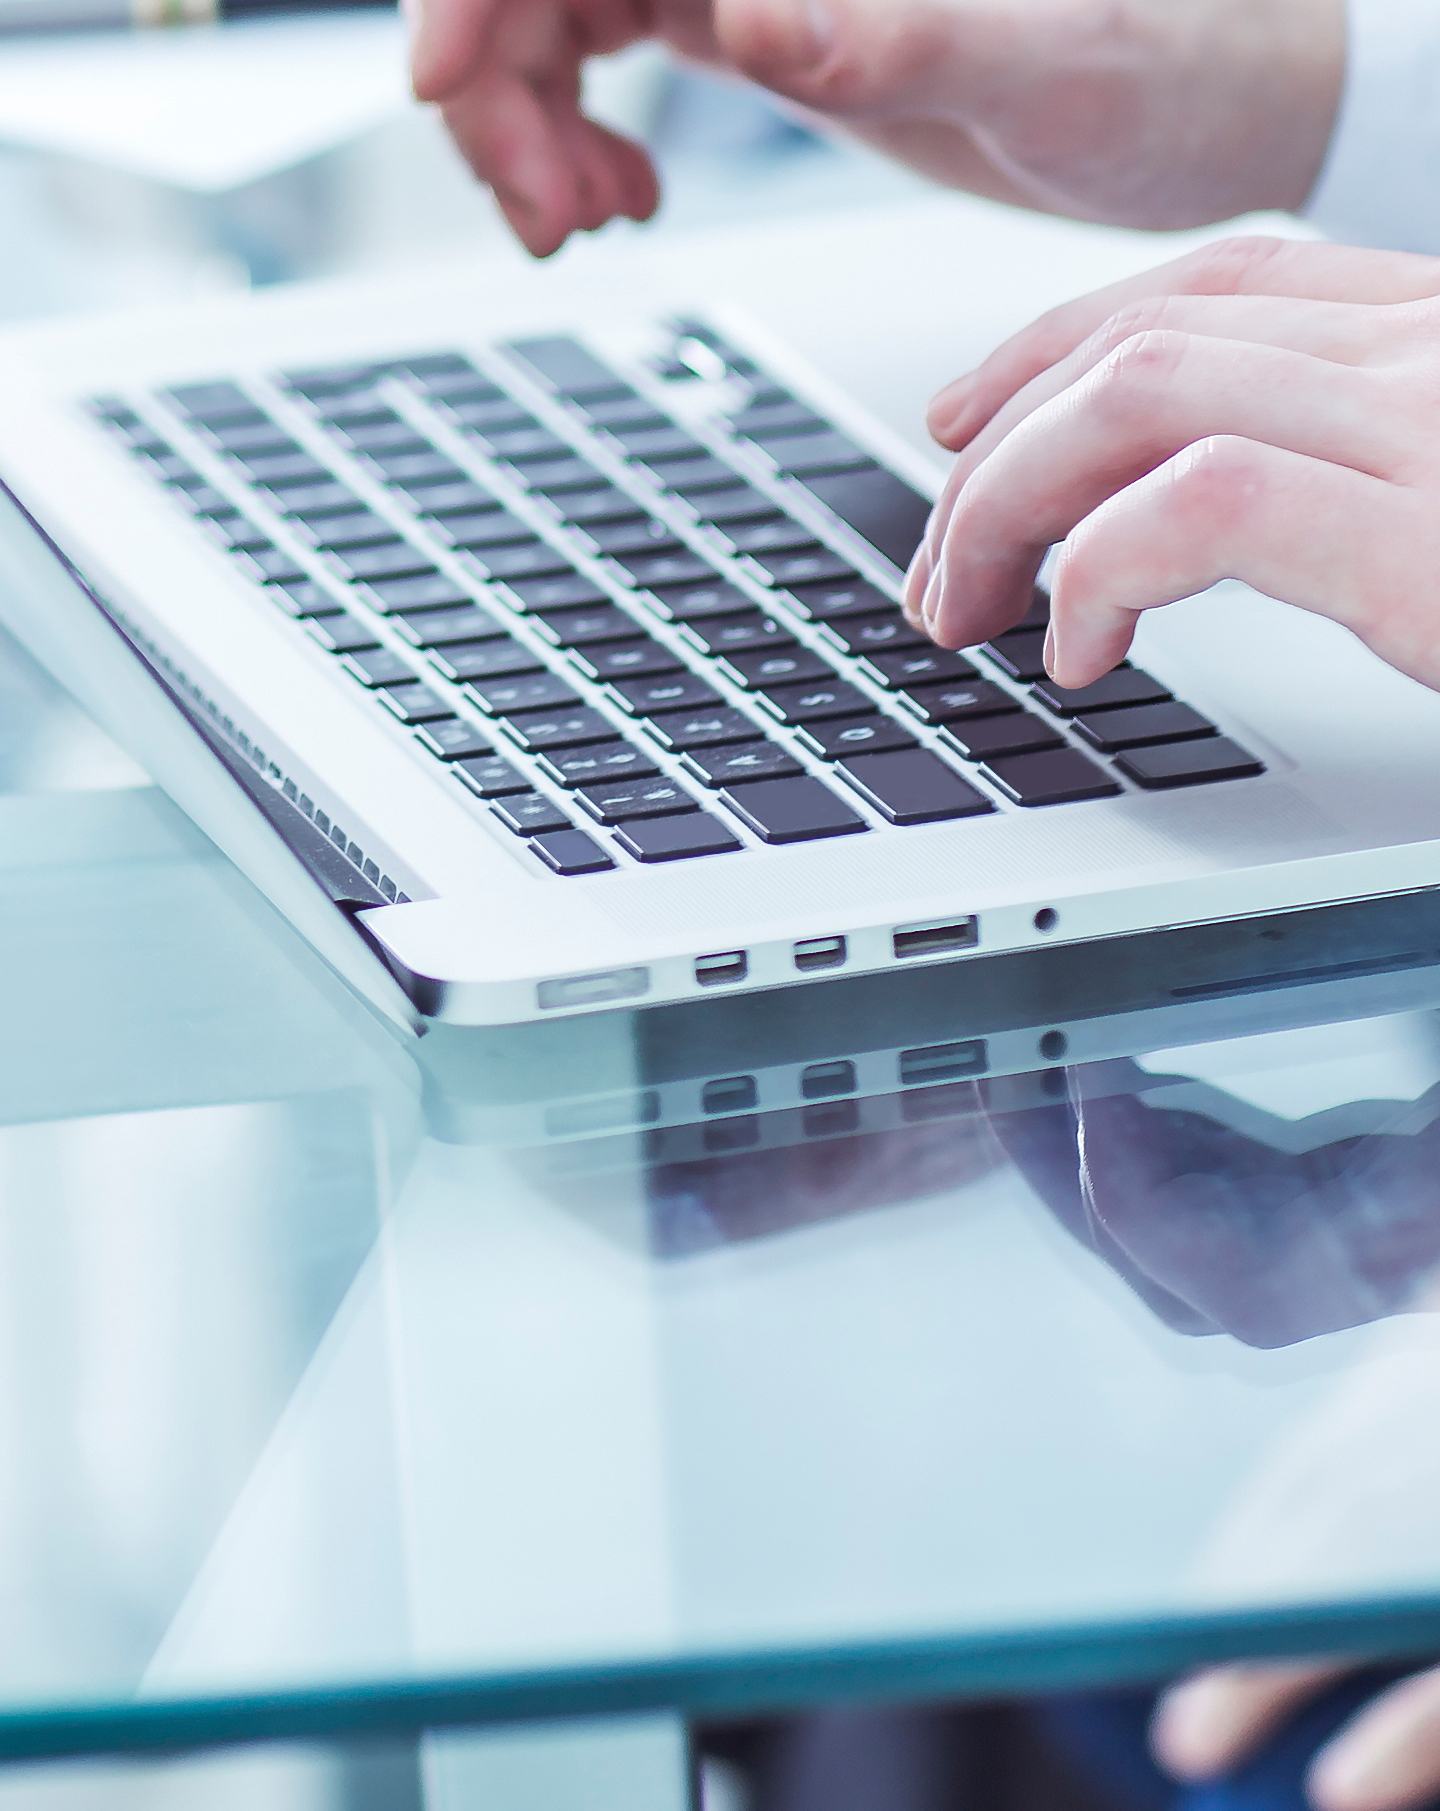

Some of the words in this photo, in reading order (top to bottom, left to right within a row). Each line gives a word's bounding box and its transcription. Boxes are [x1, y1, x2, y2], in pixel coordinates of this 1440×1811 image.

[860, 624, 897, 640] C
[799, 692, 835, 706] S
[839, 727, 875, 740] Q
[561, 758, 597, 770] 2
[725, 754, 764, 766] A
